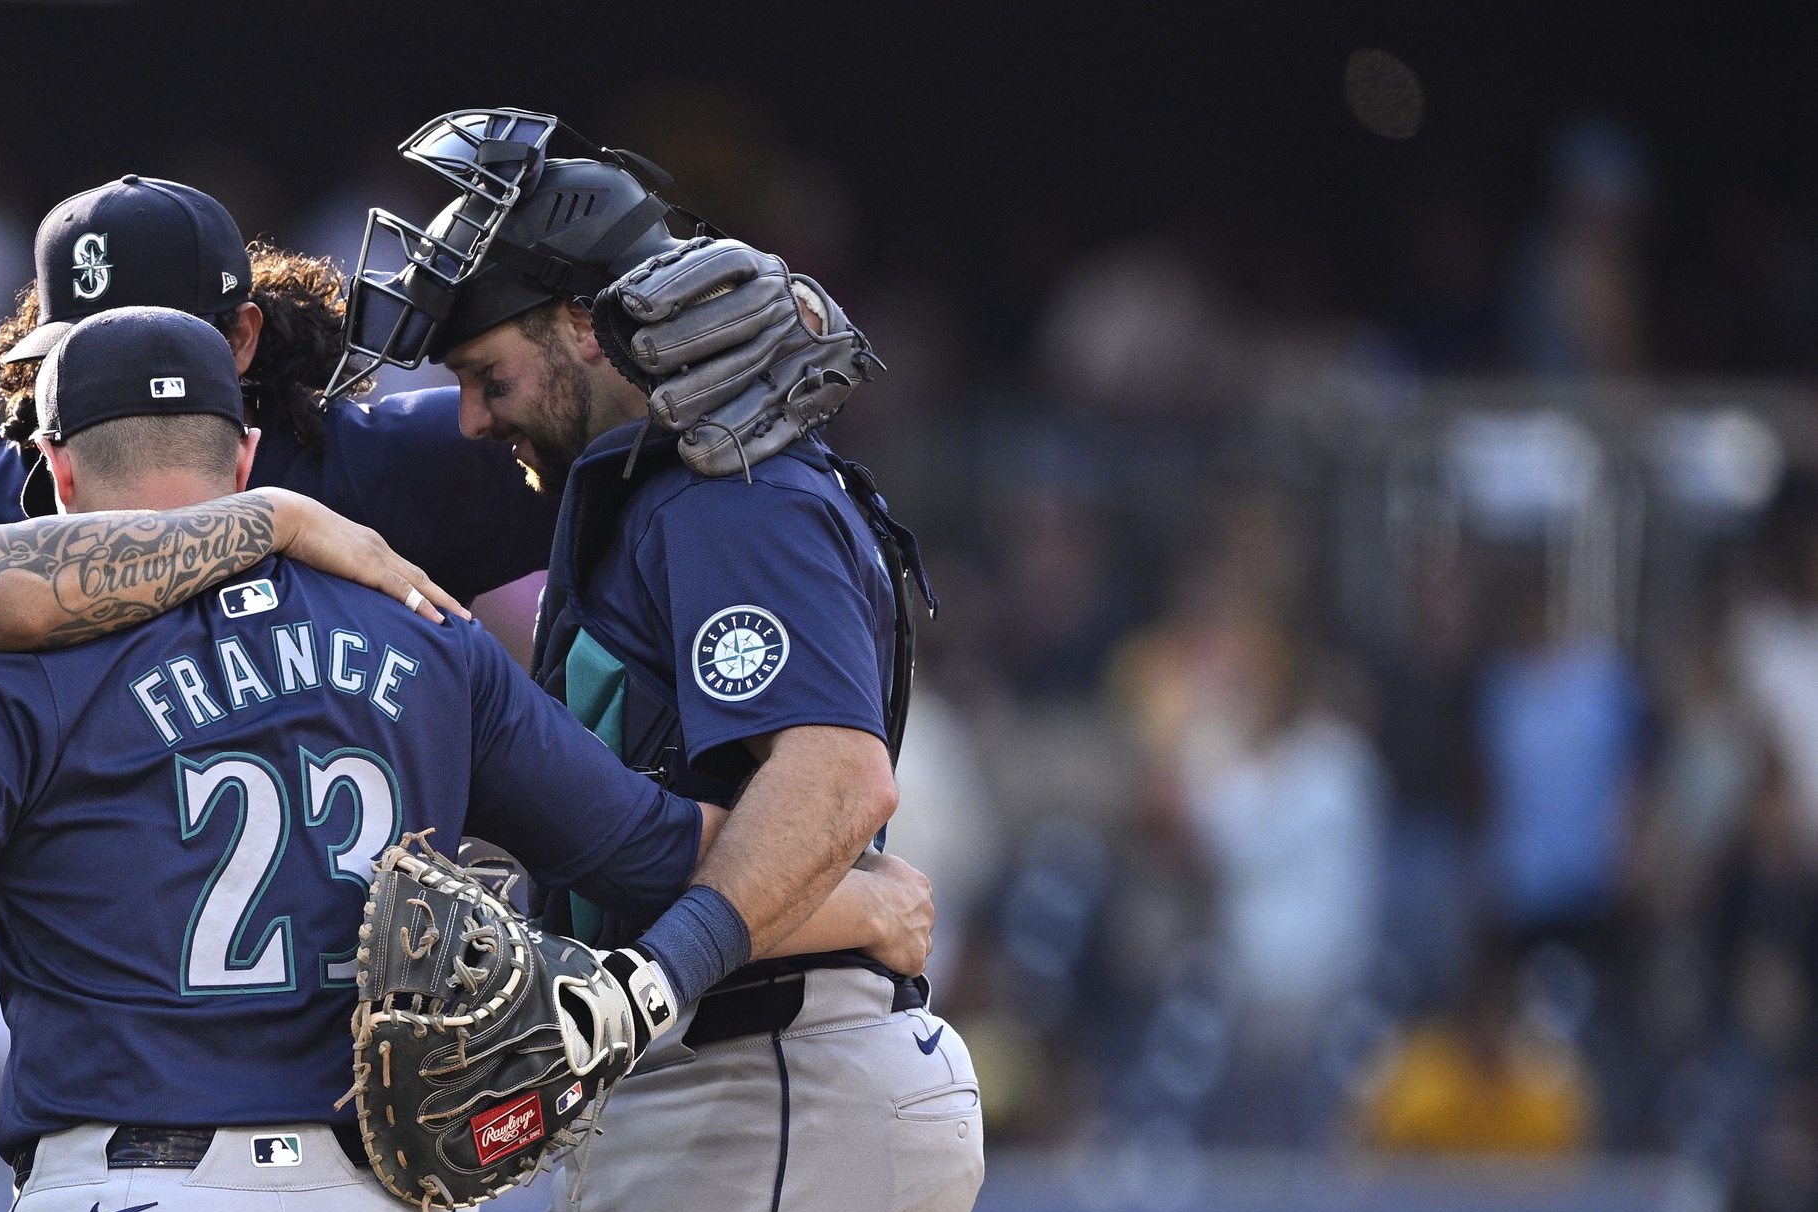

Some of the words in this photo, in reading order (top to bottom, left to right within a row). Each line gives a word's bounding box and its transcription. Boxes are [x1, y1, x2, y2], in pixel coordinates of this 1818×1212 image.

[66, 514, 236, 606] Crawford
[701, 614, 774, 653] SEATTLE
[128, 620, 420, 747] FRANCE
[705, 654, 779, 692] MARINERS
[174, 745, 403, 996] 23
[481, 1108, 536, 1147] Rawlings
